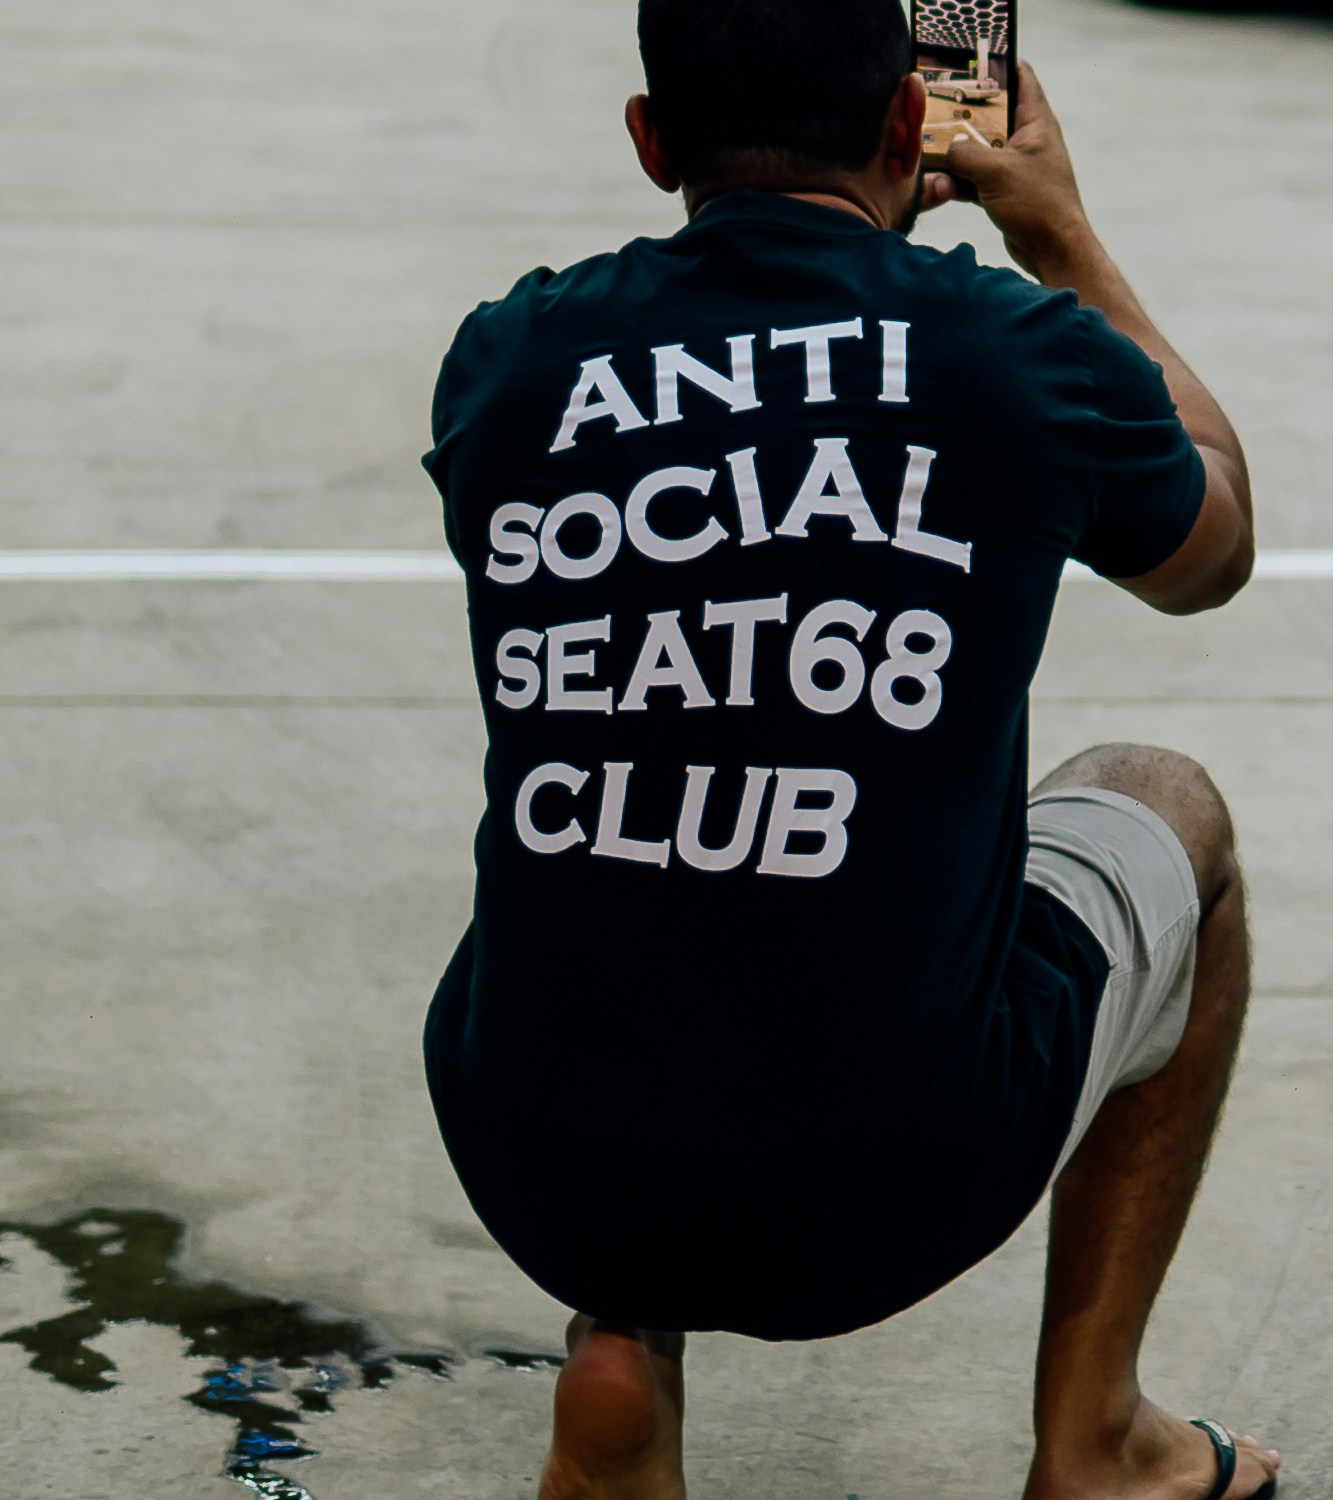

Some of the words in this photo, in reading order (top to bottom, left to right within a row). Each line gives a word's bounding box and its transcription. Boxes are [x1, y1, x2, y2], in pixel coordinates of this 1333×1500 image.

[549, 317, 911, 453] ANTI
[486, 437, 972, 584] SOCIAL
[495, 592, 952, 730] SEAT68
[515, 761, 857, 877] CLUB
